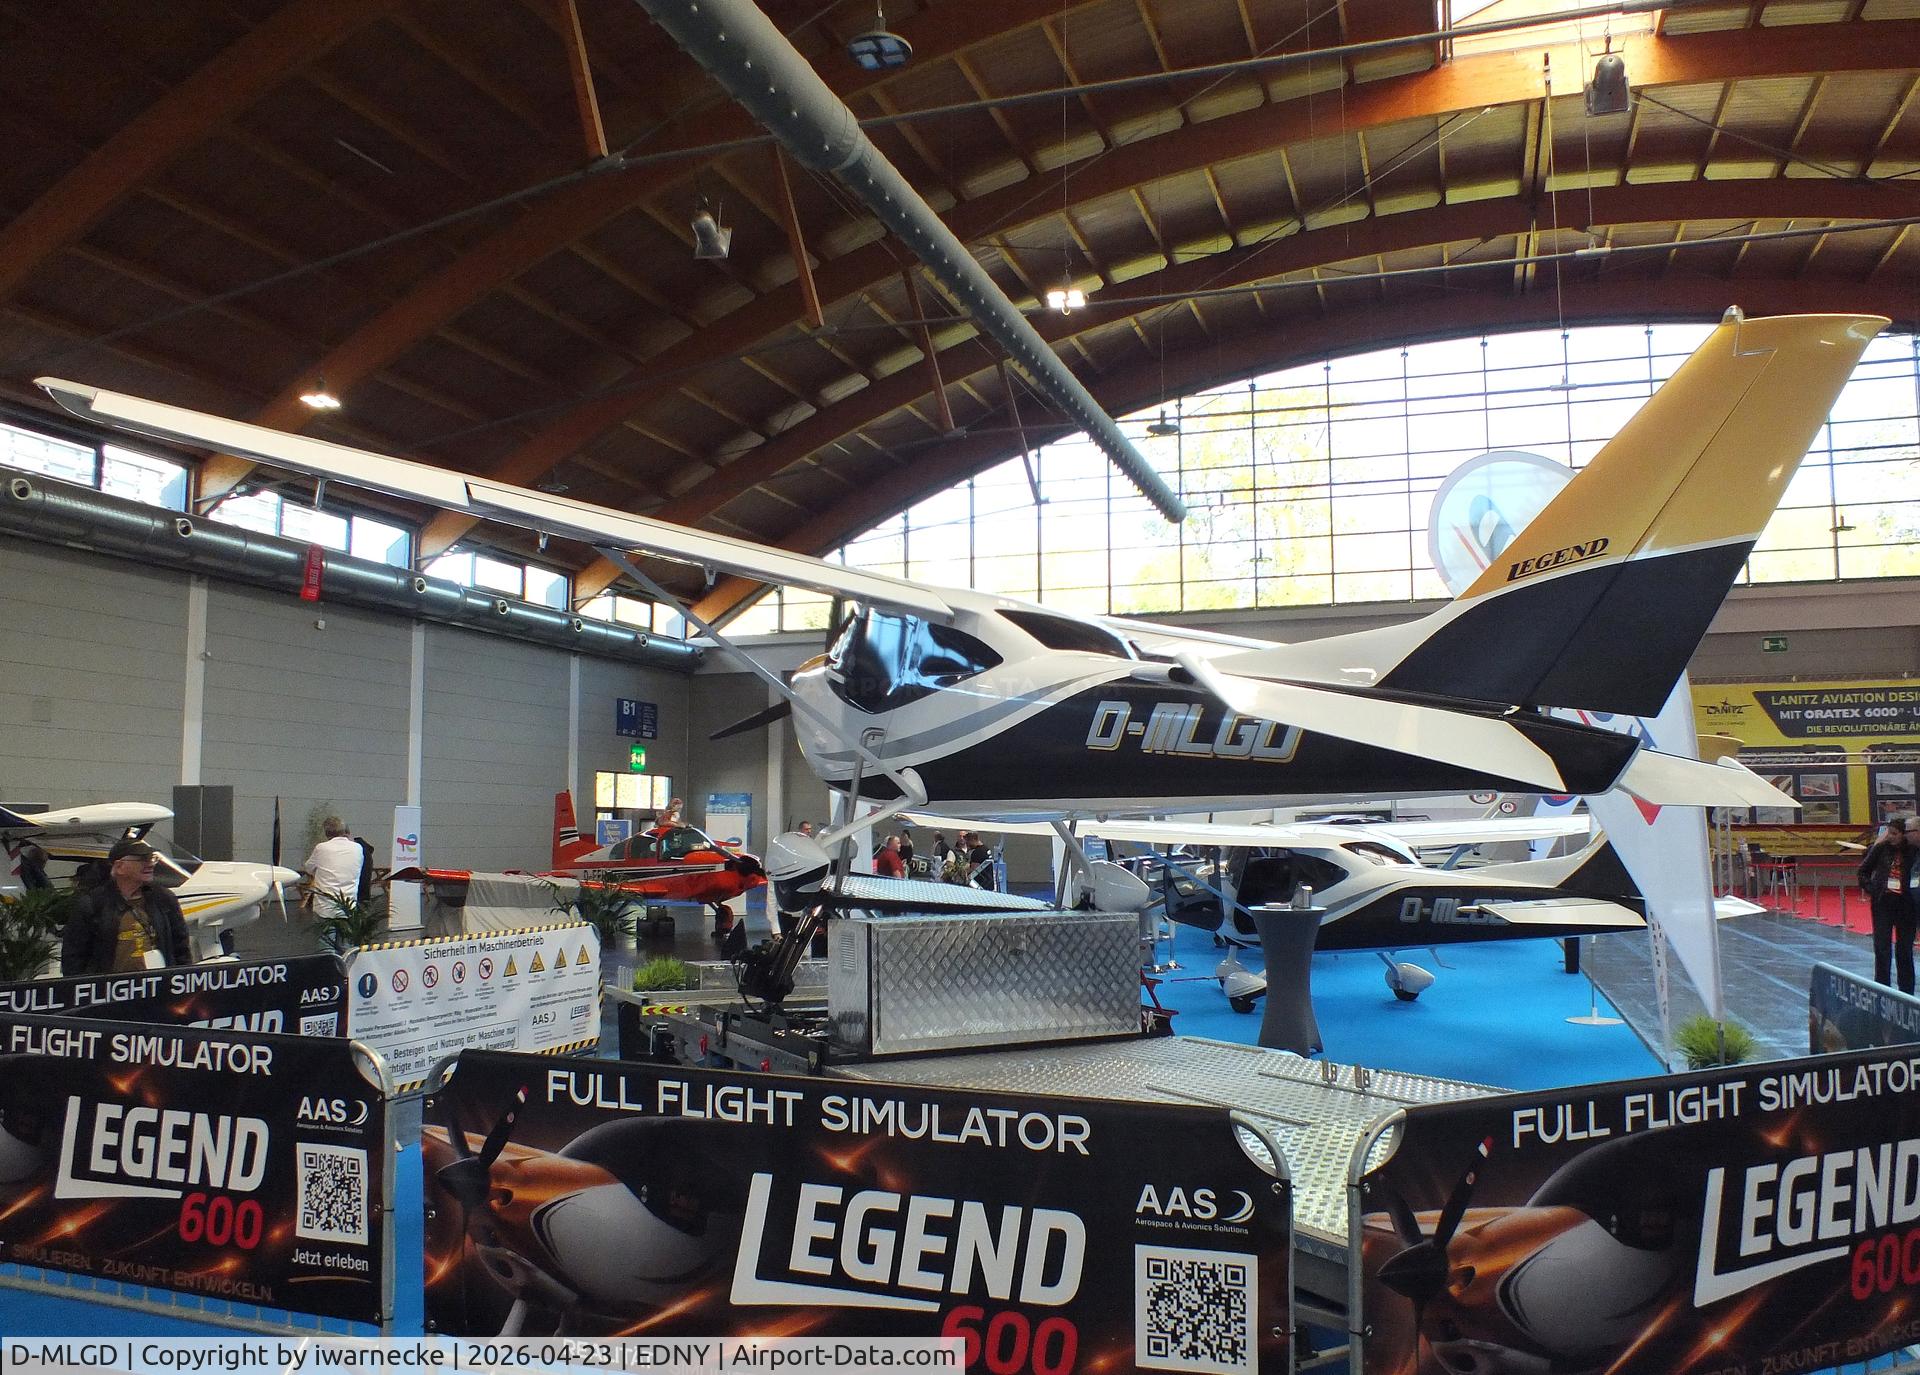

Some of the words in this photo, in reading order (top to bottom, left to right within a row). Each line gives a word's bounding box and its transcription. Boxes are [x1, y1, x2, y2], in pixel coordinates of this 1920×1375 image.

[1507, 538, 1609, 581] LEGEND
[623, 700, 636, 716] B1
[1771, 695, 1818, 705] LANITZ
[1822, 693, 1885, 704] AVIATION
[1780, 710, 1801, 720] MIT
[1804, 709, 1860, 719] ORATEX
[1825, 722, 1906, 733] REVOLUTIONÄRE
[424, 945, 465, 960] Sicherheit
[467, 944, 477, 955] im
[480, 936, 544, 952] Maschinenbetrieb
[75, 976, 162, 1006] FLIGHT
[170, 964, 287, 995] SIMULATOR
[300, 987, 330, 1003] AAS
[531, 1012, 549, 1025] AAS
[12, 1025, 102, 1060] FLIGHT
[110, 1034, 273, 1076] SIMULATOR
[394, 1046, 425, 1060] Besteigen
[428, 1042, 438, 1052] und
[441, 1036, 464, 1048] Nutzung
[467, 1034, 477, 1044] der
[479, 1027, 505, 1040] Maschine
[297, 1096, 347, 1122] AAS
[546, 1069, 643, 1112] FULL
[657, 1080, 804, 1127] FLIGHT
[821, 1095, 1092, 1155] SIMULATOR
[1512, 1101, 1611, 1149] FULL
[1625, 1081, 1747, 1133] FLIGHT
[54, 1095, 269, 1199] LEGEND
[1136, 1184, 1217, 1219] AAS
[179, 1192, 264, 1250] 600
[1135, 1217, 1173, 1229] Aerospace
[1175, 1221, 1180, 1229] &
[1182, 1221, 1213, 1232] Avionics
[1214, 1223, 1249, 1235] Solutions
[1694, 1138, 1920, 1307] LEGEND
[729, 1172, 1087, 1311] LEGEND
[103, 1258, 170, 1284] ZUKUNFT
[292, 1248, 321, 1267] Jetzt
[325, 1253, 369, 1272] erleben
[940, 1305, 1079, 1375] 600
